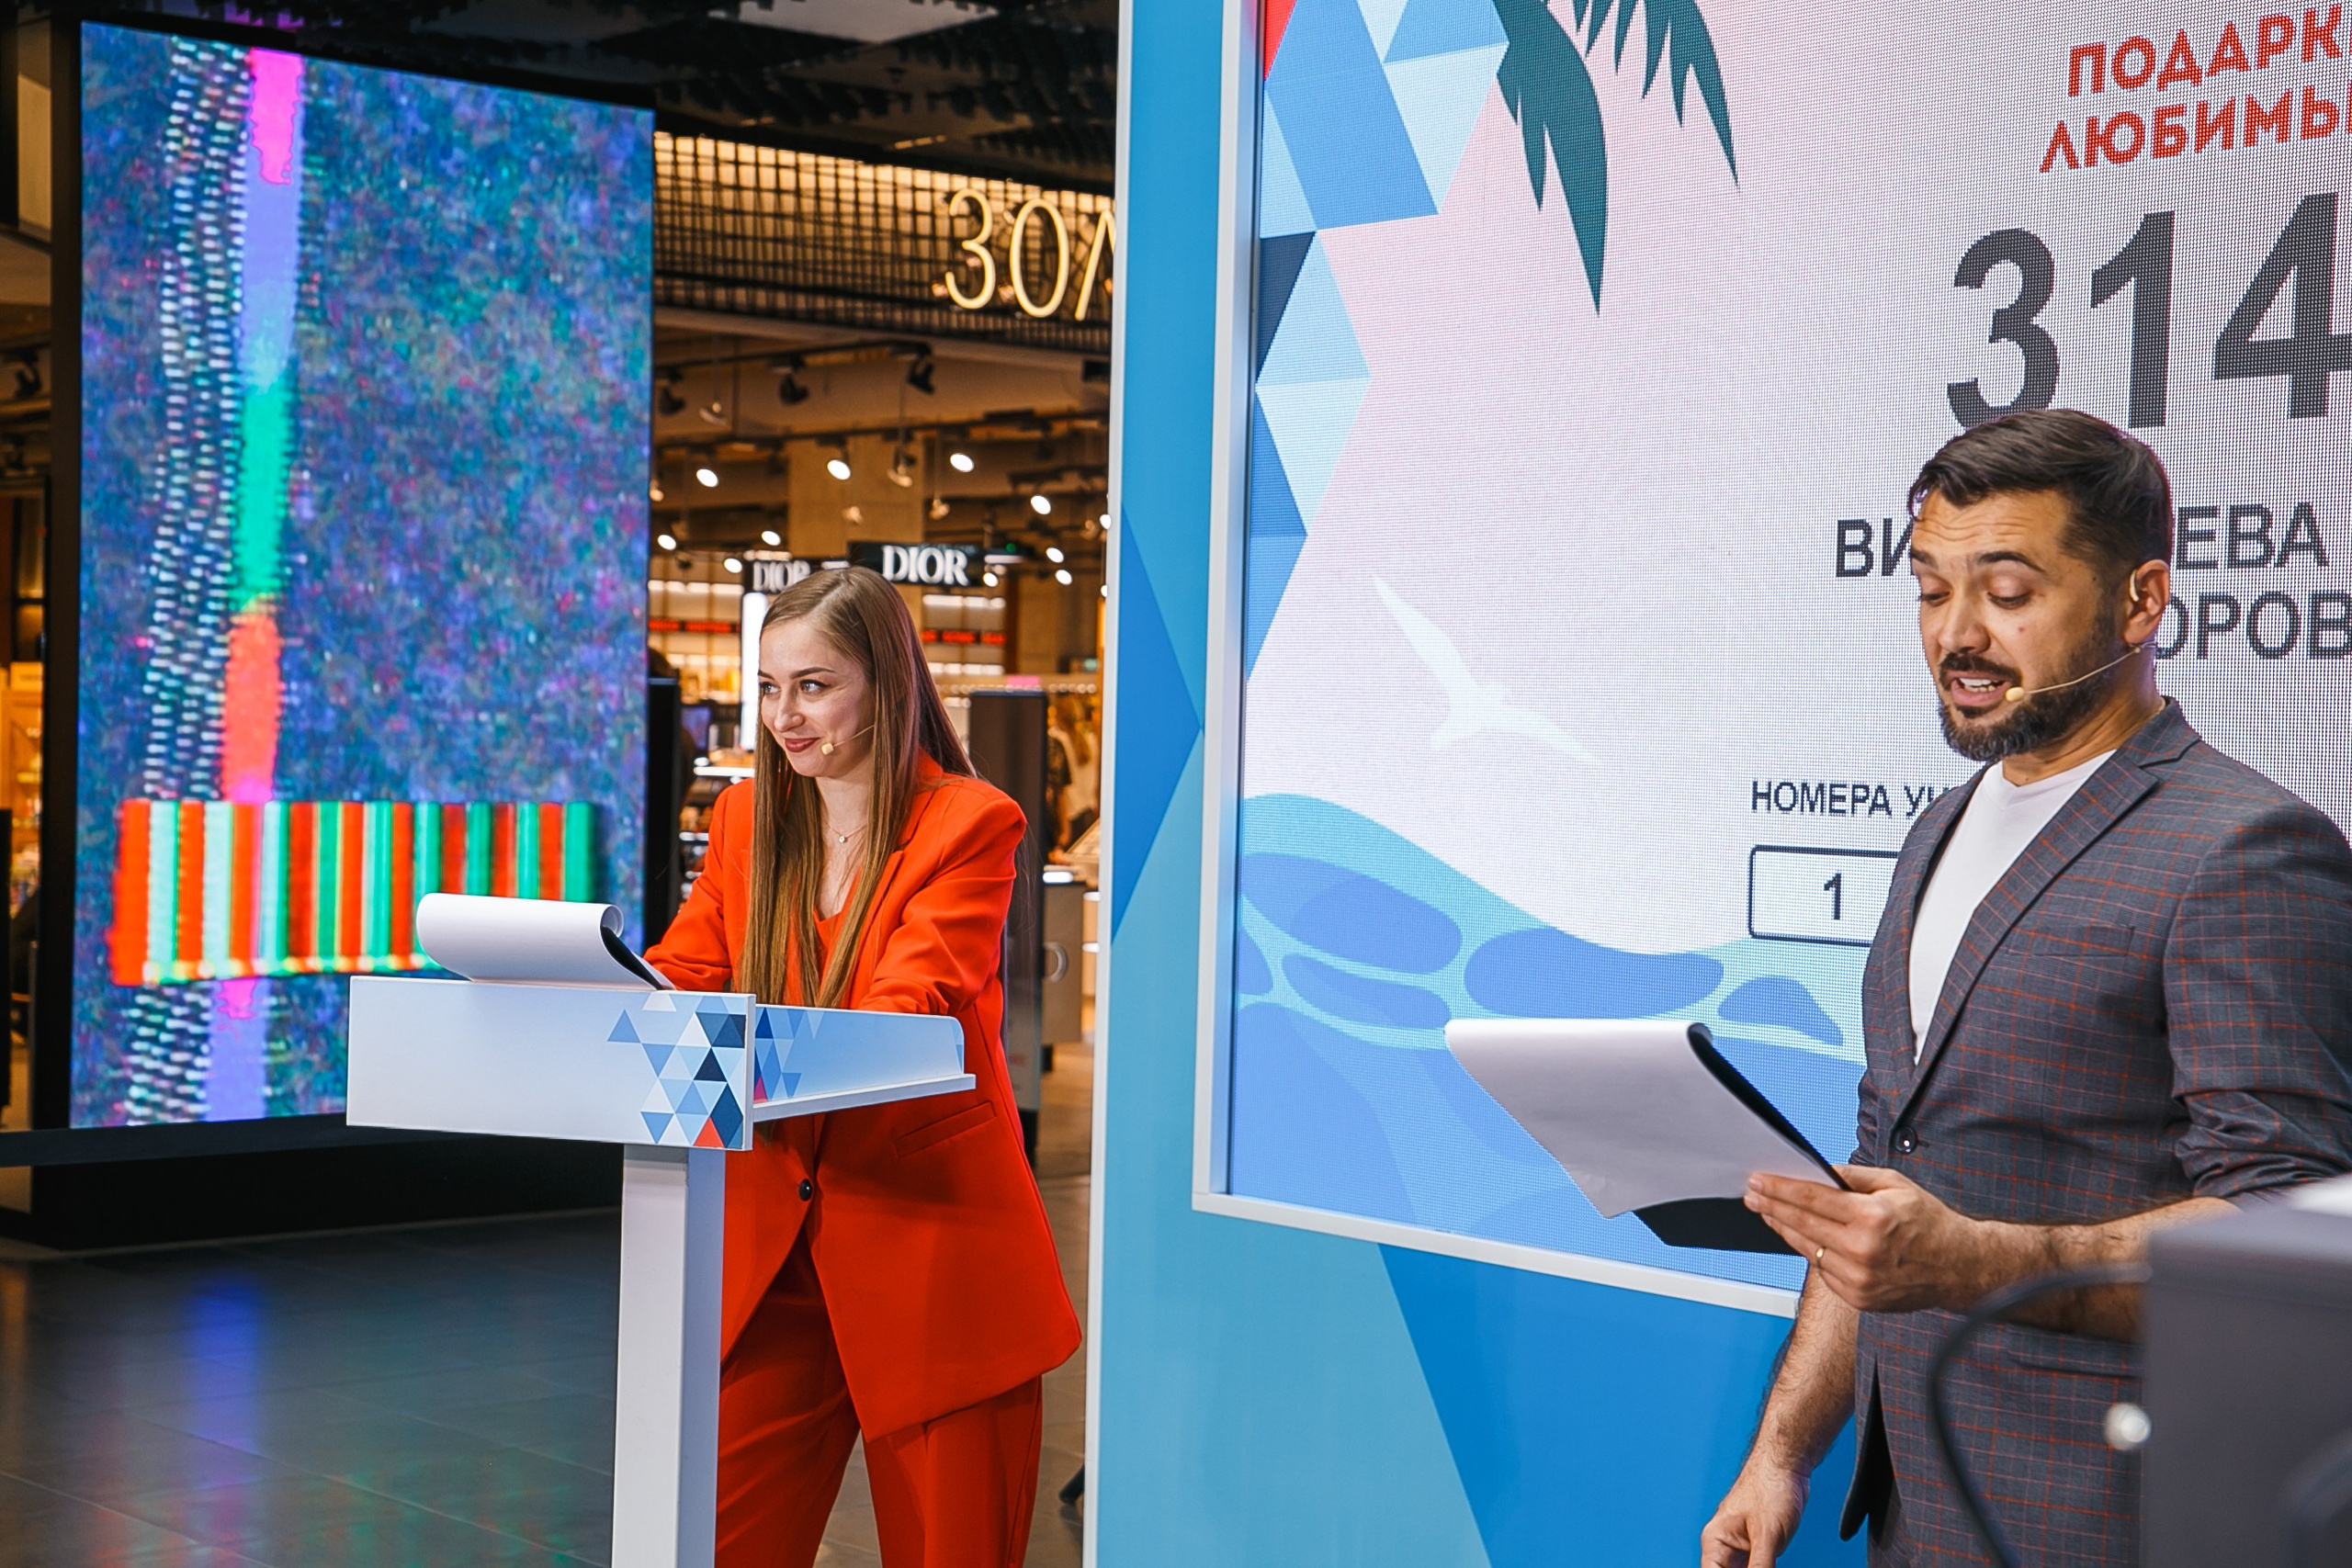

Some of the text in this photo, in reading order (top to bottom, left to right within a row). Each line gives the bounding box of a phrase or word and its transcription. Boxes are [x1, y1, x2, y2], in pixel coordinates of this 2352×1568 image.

[2068, 3, 2352, 96] ПОДАРК
[1947, 192, 2352, 429] 314
[882, 545, 969, 586] DIOR
[1751, 780, 1893, 816] НОМЕРА
[1823, 872, 1842, 920] 1
